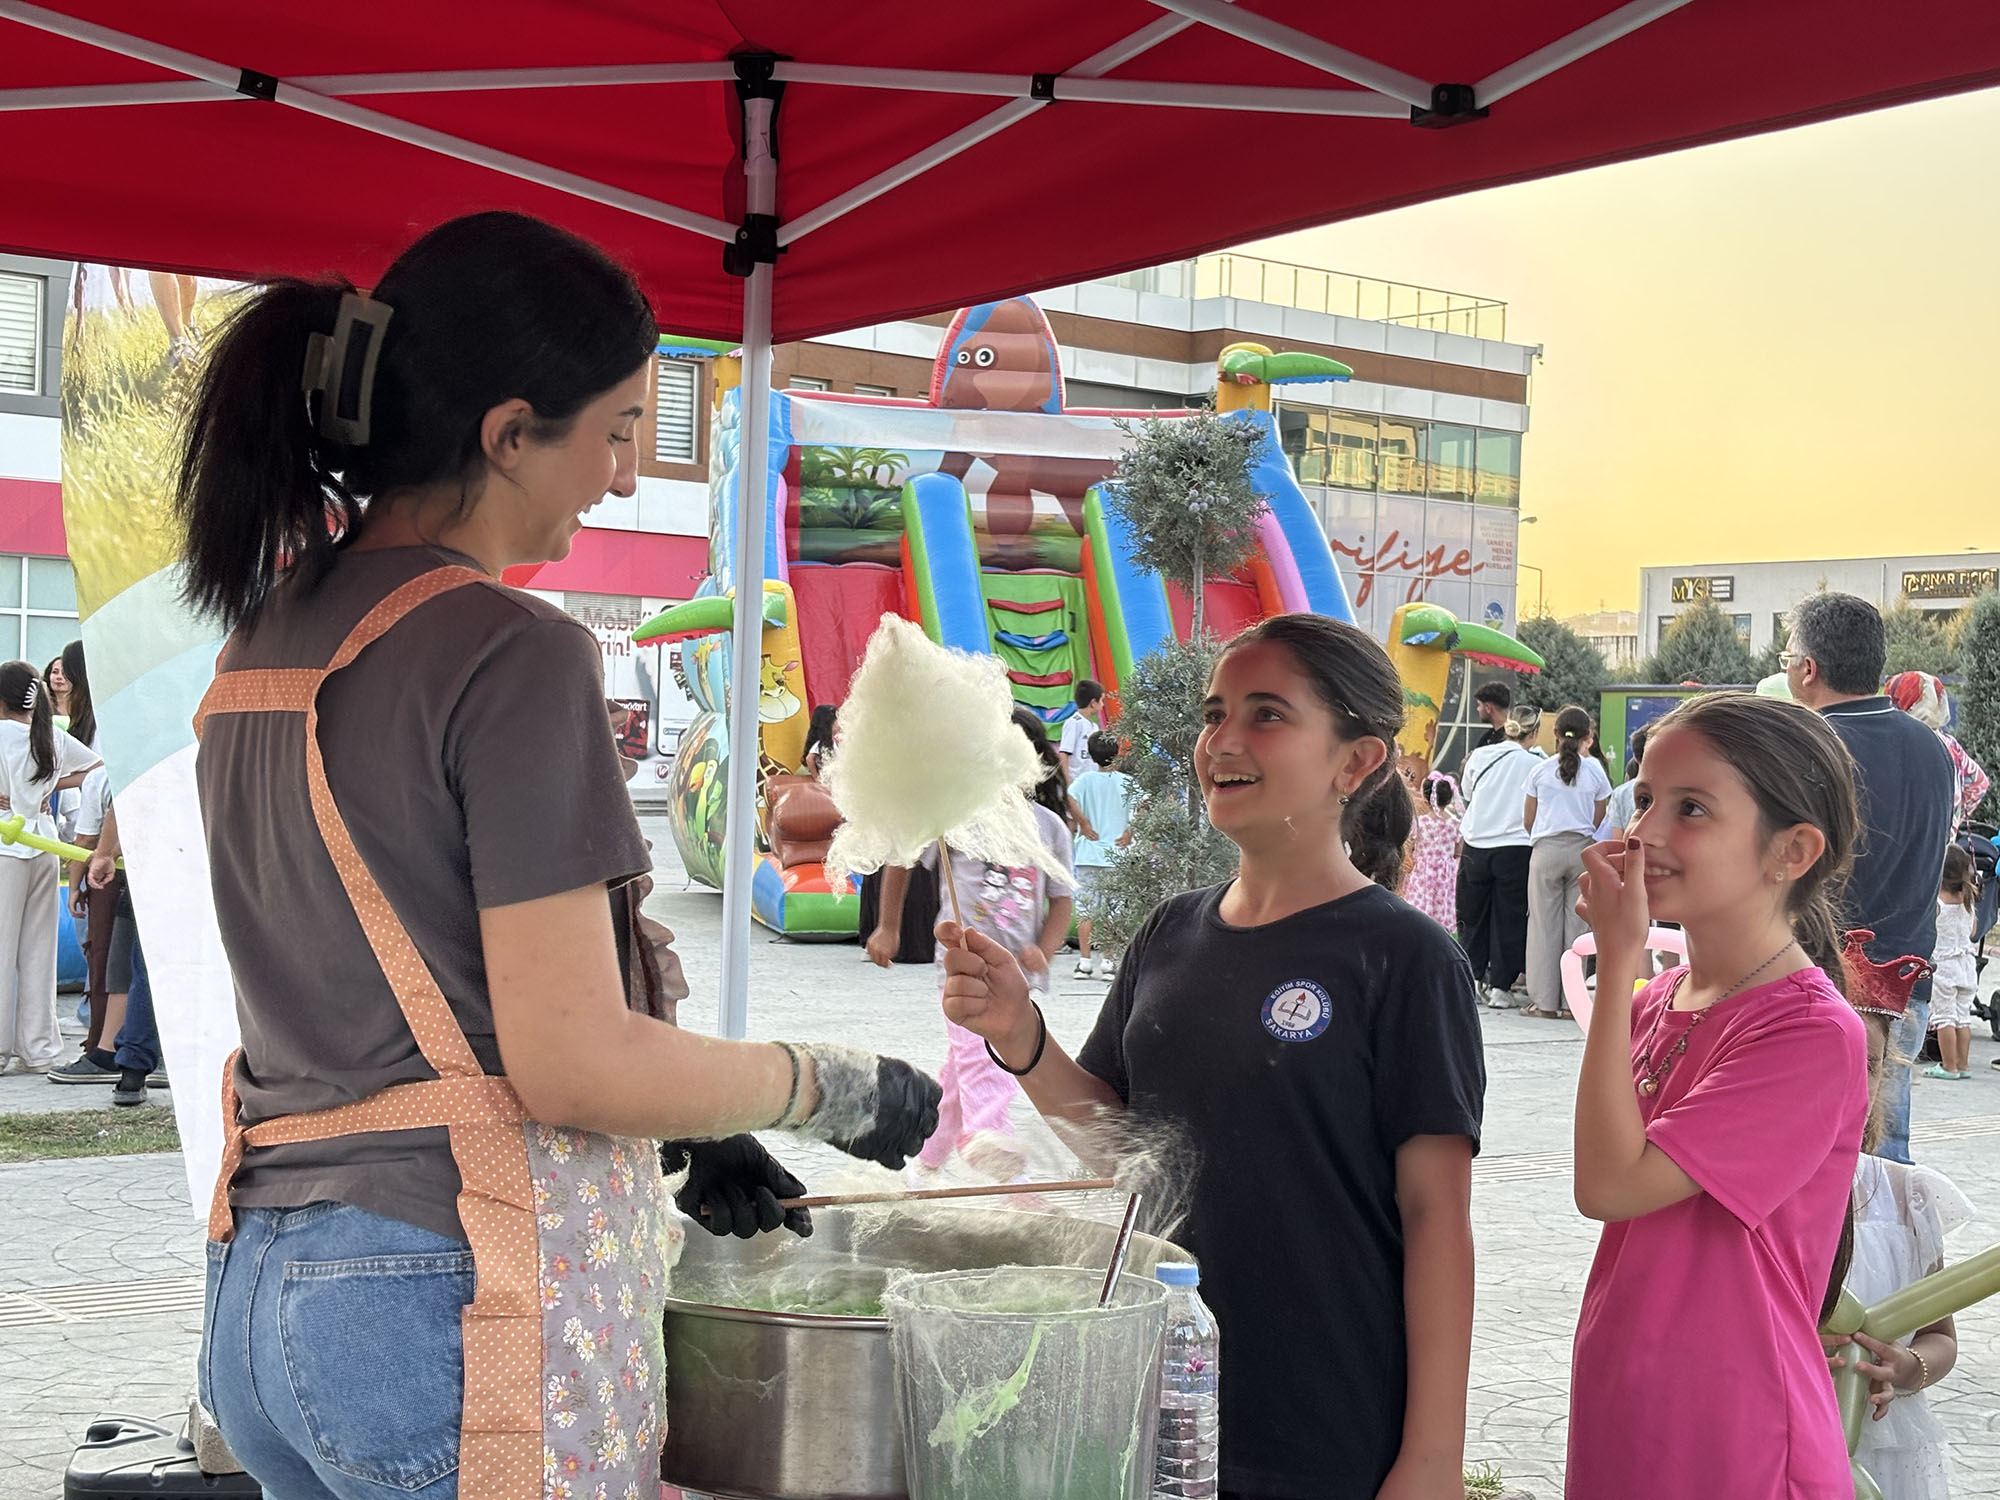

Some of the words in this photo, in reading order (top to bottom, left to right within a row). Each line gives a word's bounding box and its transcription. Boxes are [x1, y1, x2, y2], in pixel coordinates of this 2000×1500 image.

[1330, 530, 1486, 608] rifiye
[599, 634, 631, 657] rin!
[1295, 980, 1317, 991] SPOR
[1265, 1018, 1313, 1040] SAKARYA
